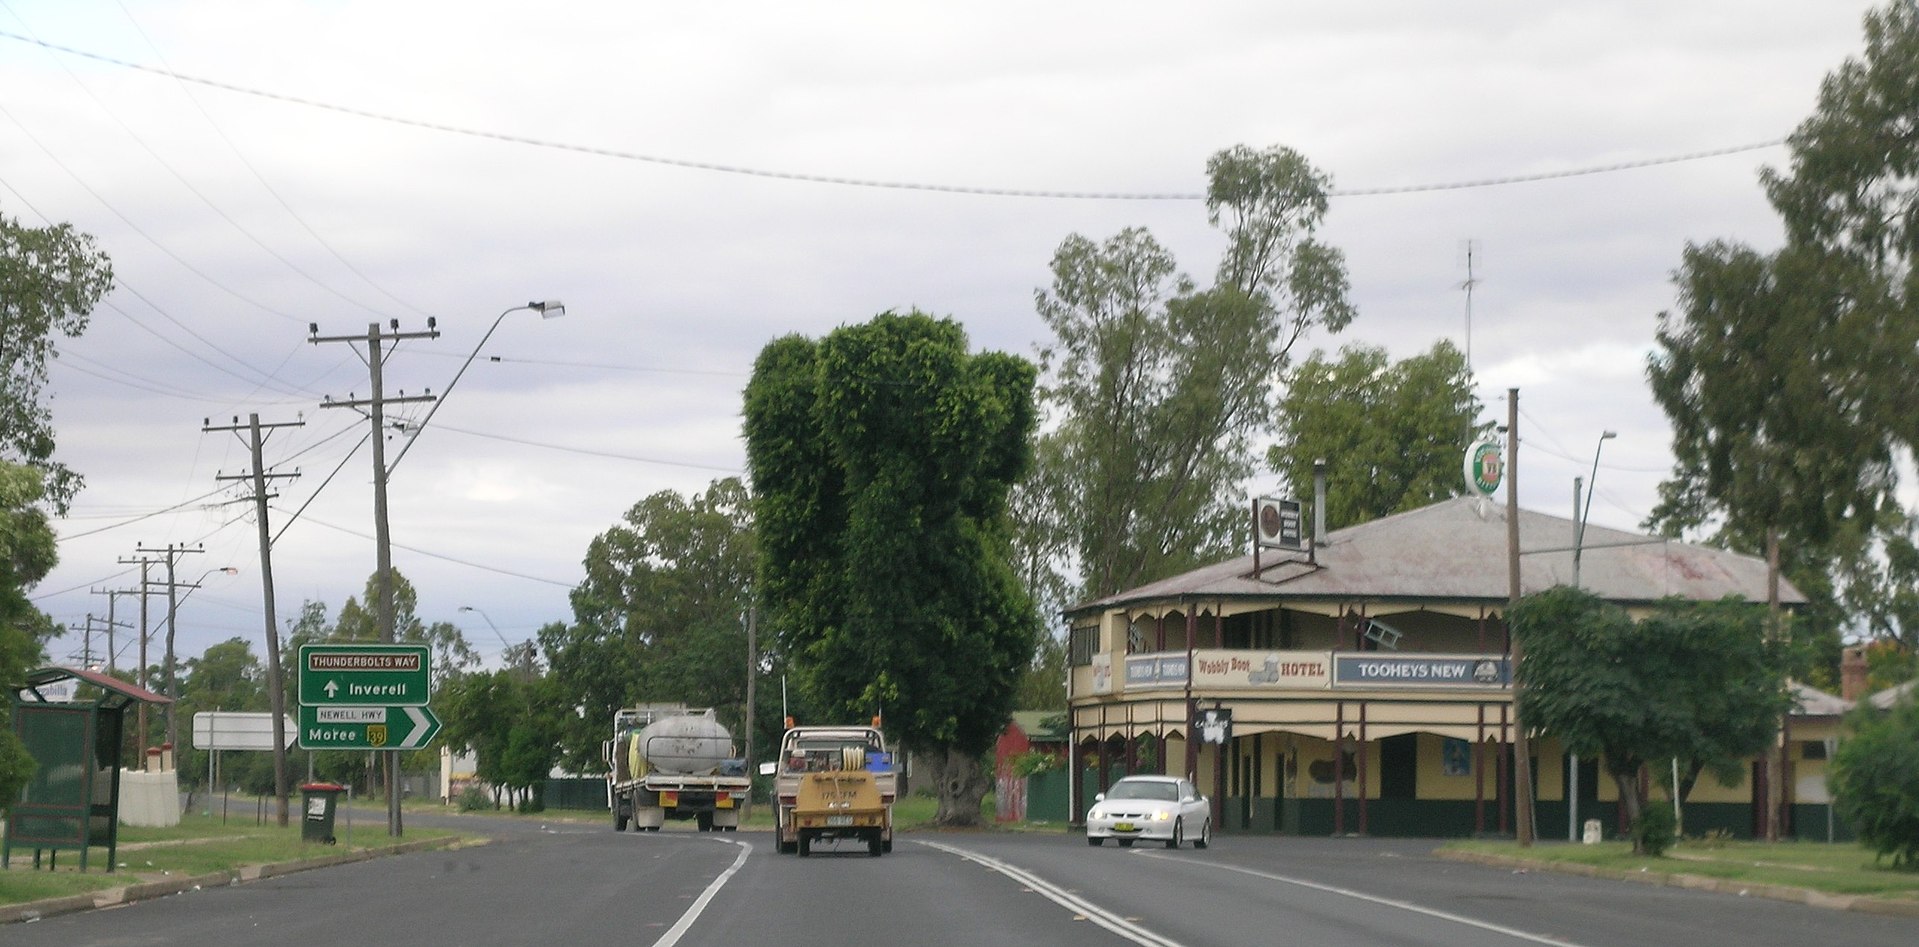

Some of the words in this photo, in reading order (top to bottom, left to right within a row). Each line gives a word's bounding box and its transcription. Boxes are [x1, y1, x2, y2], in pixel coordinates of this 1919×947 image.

[312, 656, 392, 667] THUNDERBOLTS
[394, 656, 417, 667] WAY
[1199, 659, 1229, 676] Wobbly
[1231, 657, 1250, 672] Boot
[1281, 662, 1325, 676] HOTEL
[1358, 663, 1428, 678] TOOHEYS
[1431, 664, 1467, 678] NEW
[348, 682, 407, 696] Inverell
[320, 710, 357, 720] NEWELL
[361, 710, 382, 720] HWY
[308, 728, 357, 741] Moree
[369, 731, 384, 743] 39
